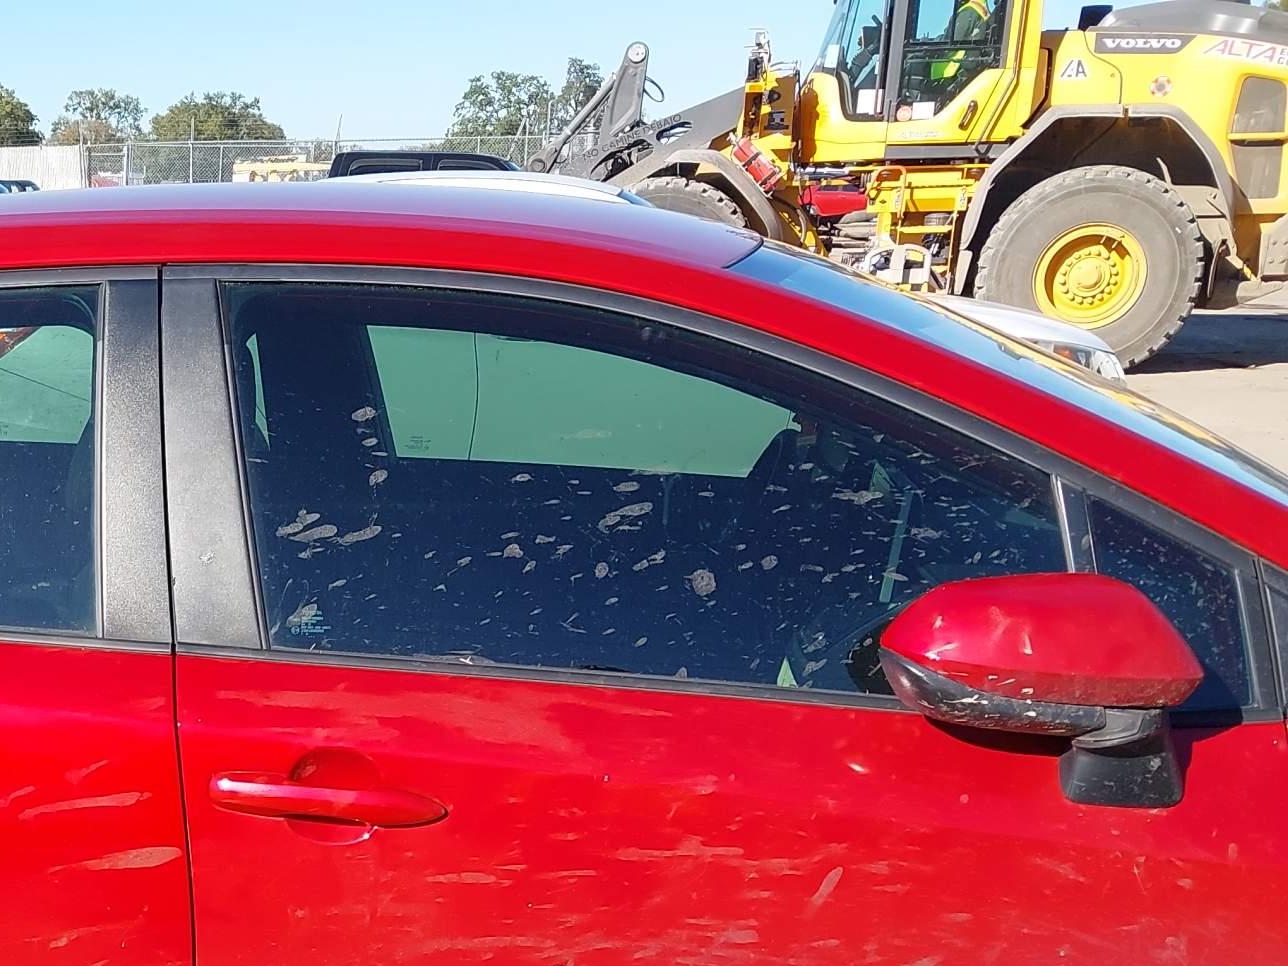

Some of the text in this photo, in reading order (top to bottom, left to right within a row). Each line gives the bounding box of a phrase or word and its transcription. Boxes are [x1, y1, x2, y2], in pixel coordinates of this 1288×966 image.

[1101, 37, 1183, 49] VOLVO
[1203, 39, 1277, 62] ALTA
[601, 130, 641, 152] CAMINE
